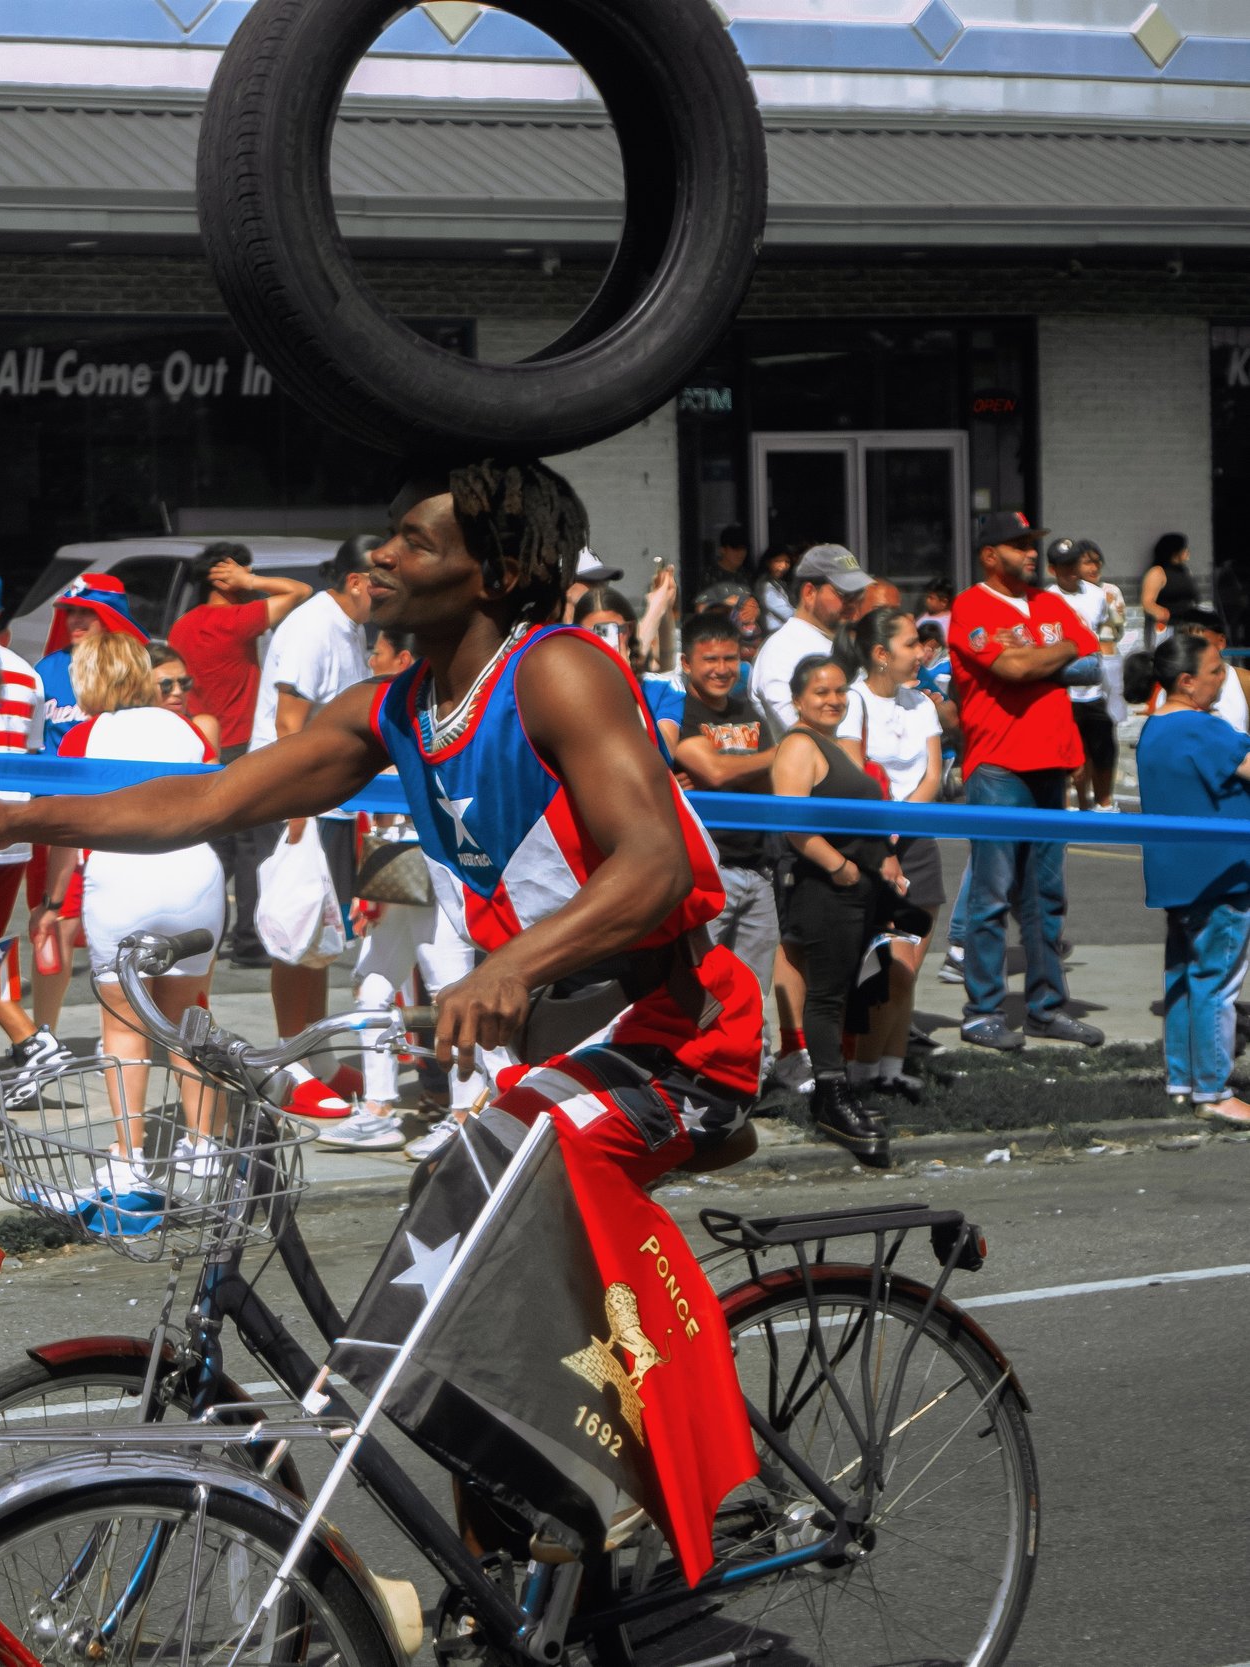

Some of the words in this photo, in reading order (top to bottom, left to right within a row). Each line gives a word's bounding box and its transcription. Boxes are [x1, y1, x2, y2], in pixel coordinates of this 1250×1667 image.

[54, 349, 151, 396] Come
[163, 350, 229, 397] Out
[241, 351, 273, 395] In
[973, 398, 1016, 413] OPEN
[639, 1235, 700, 1342] PONCE
[573, 1405, 623, 1458] 1692
